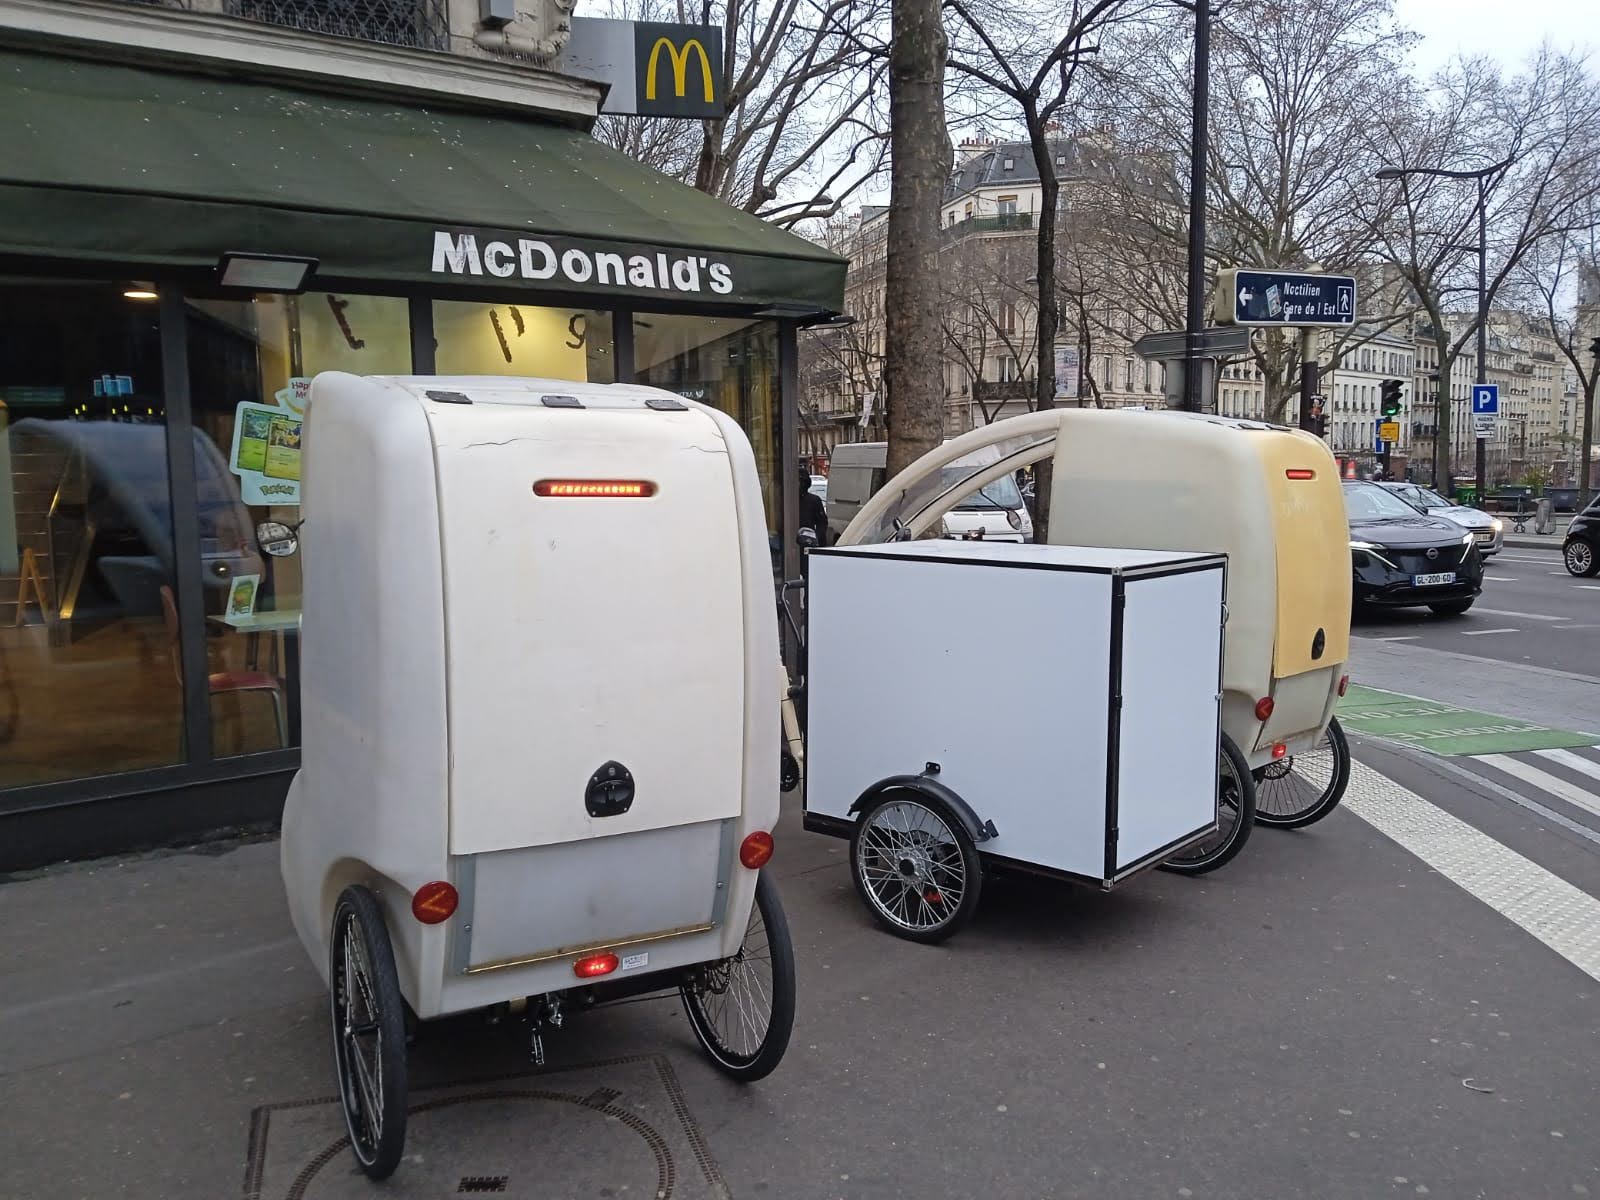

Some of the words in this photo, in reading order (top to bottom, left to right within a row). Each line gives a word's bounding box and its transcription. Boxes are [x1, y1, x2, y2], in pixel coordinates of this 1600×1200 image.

[431, 230, 734, 295] McDonald's
[1283, 281, 1321, 297] Noctilien
[1283, 301, 1303, 316] Gare
[1305, 302, 1315, 316] de
[1479, 390, 1492, 409] P
